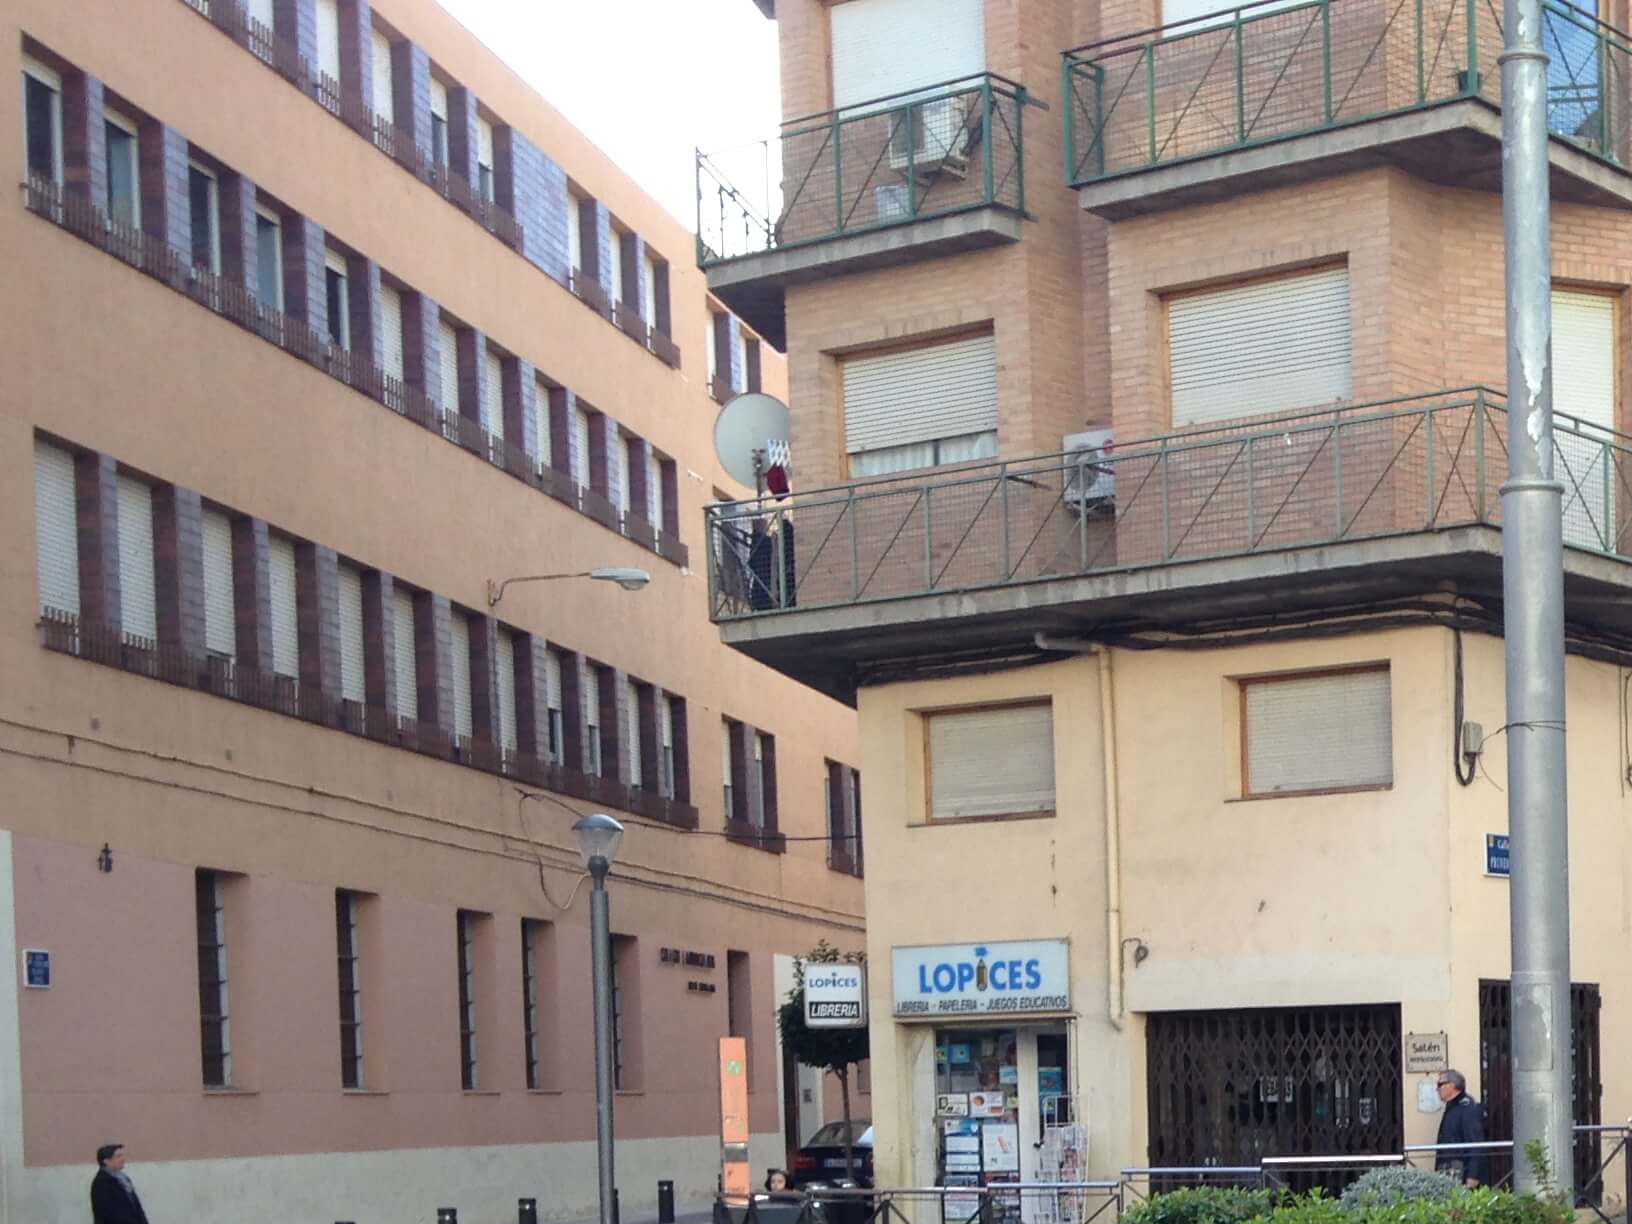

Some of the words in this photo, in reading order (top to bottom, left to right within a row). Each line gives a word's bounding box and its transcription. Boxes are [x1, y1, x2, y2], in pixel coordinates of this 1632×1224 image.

[811, 1003, 858, 1017] LIBRERIA
[897, 1001, 929, 1013] LIBRERIA
[938, 999, 977, 1011] PAPELERIA
[986, 997, 1018, 1010] JUEGOS
[1019, 995, 1067, 1008] EDUCATIVOS
